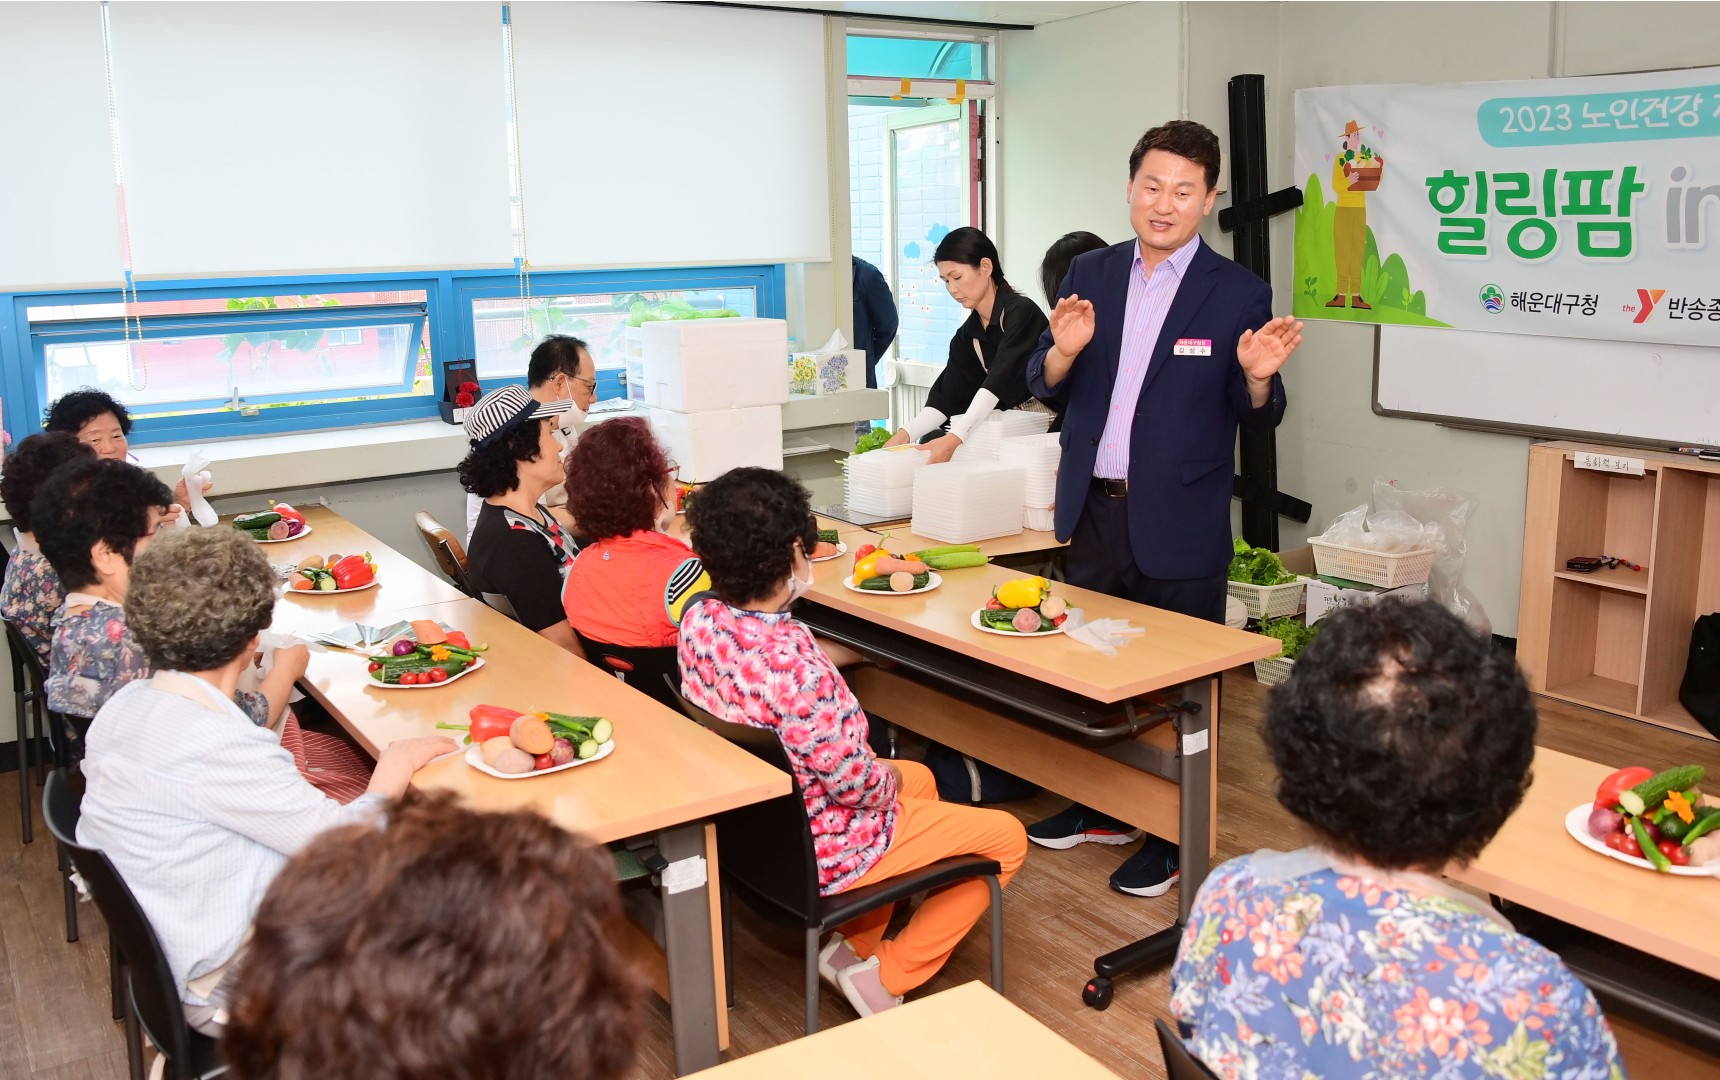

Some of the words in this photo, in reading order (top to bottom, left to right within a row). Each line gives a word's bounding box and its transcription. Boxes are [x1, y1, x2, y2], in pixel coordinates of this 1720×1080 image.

[1499, 103, 1573, 133] 2023
[1581, 93, 1704, 130] 노인건강
[1425, 165, 1645, 260] 힐링팜
[1510, 291, 1599, 316] 해운대구청
[1622, 304, 1636, 312] the
